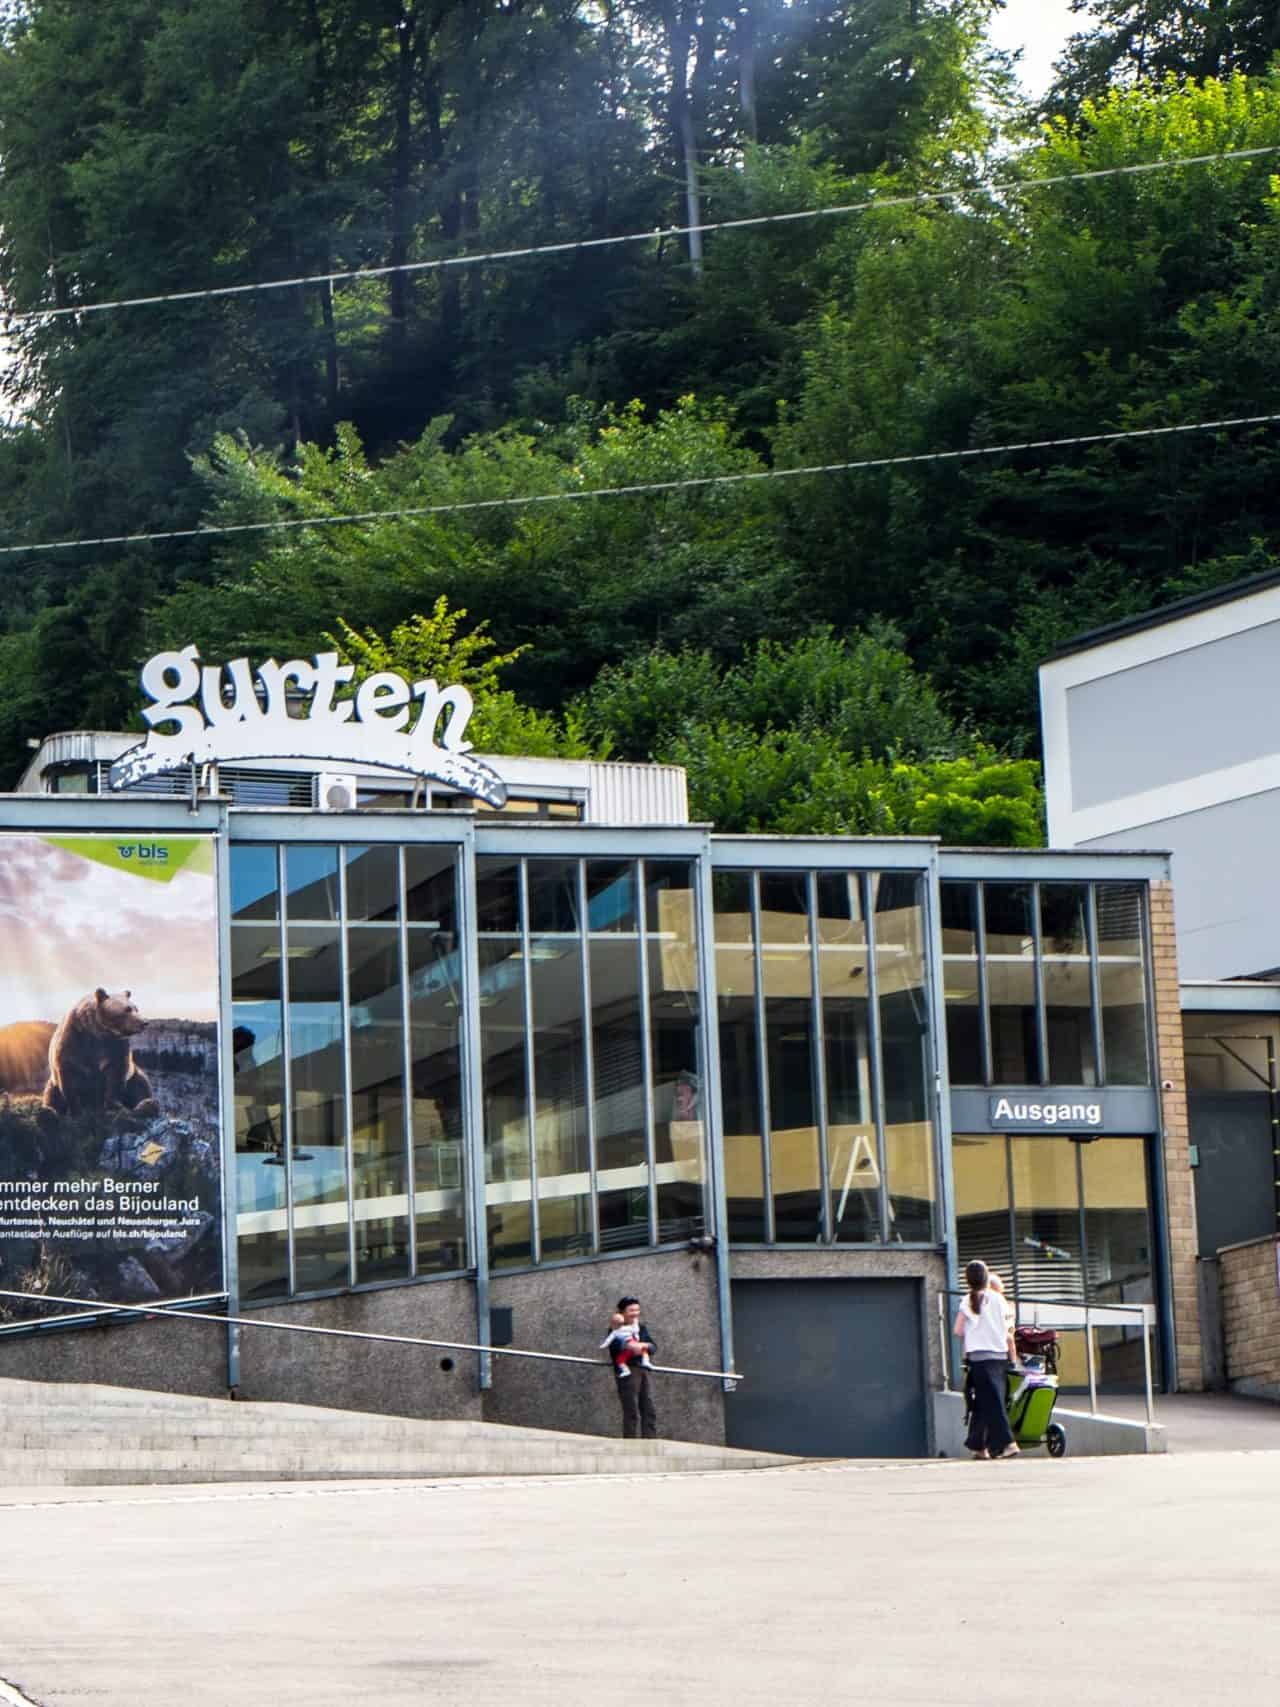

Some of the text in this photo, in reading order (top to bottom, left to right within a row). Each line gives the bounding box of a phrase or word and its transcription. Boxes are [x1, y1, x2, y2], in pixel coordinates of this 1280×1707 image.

[141, 644, 474, 754] gurten
[138, 843, 168, 859] bls
[994, 1098, 1101, 1125] Ausgang
[54, 1178, 101, 1193] mehr
[103, 1178, 161, 1193] Berner
[84, 1195, 114, 1211] das
[119, 1195, 199, 1214] Bijouland
[97, 1216, 116, 1226] und
[179, 1216, 201, 1226] Jura
[52, 1229, 94, 1240] Ausflüge
[96, 1229, 111, 1239] auf
[113, 1229, 187, 1240] bls.ch/bijouland
